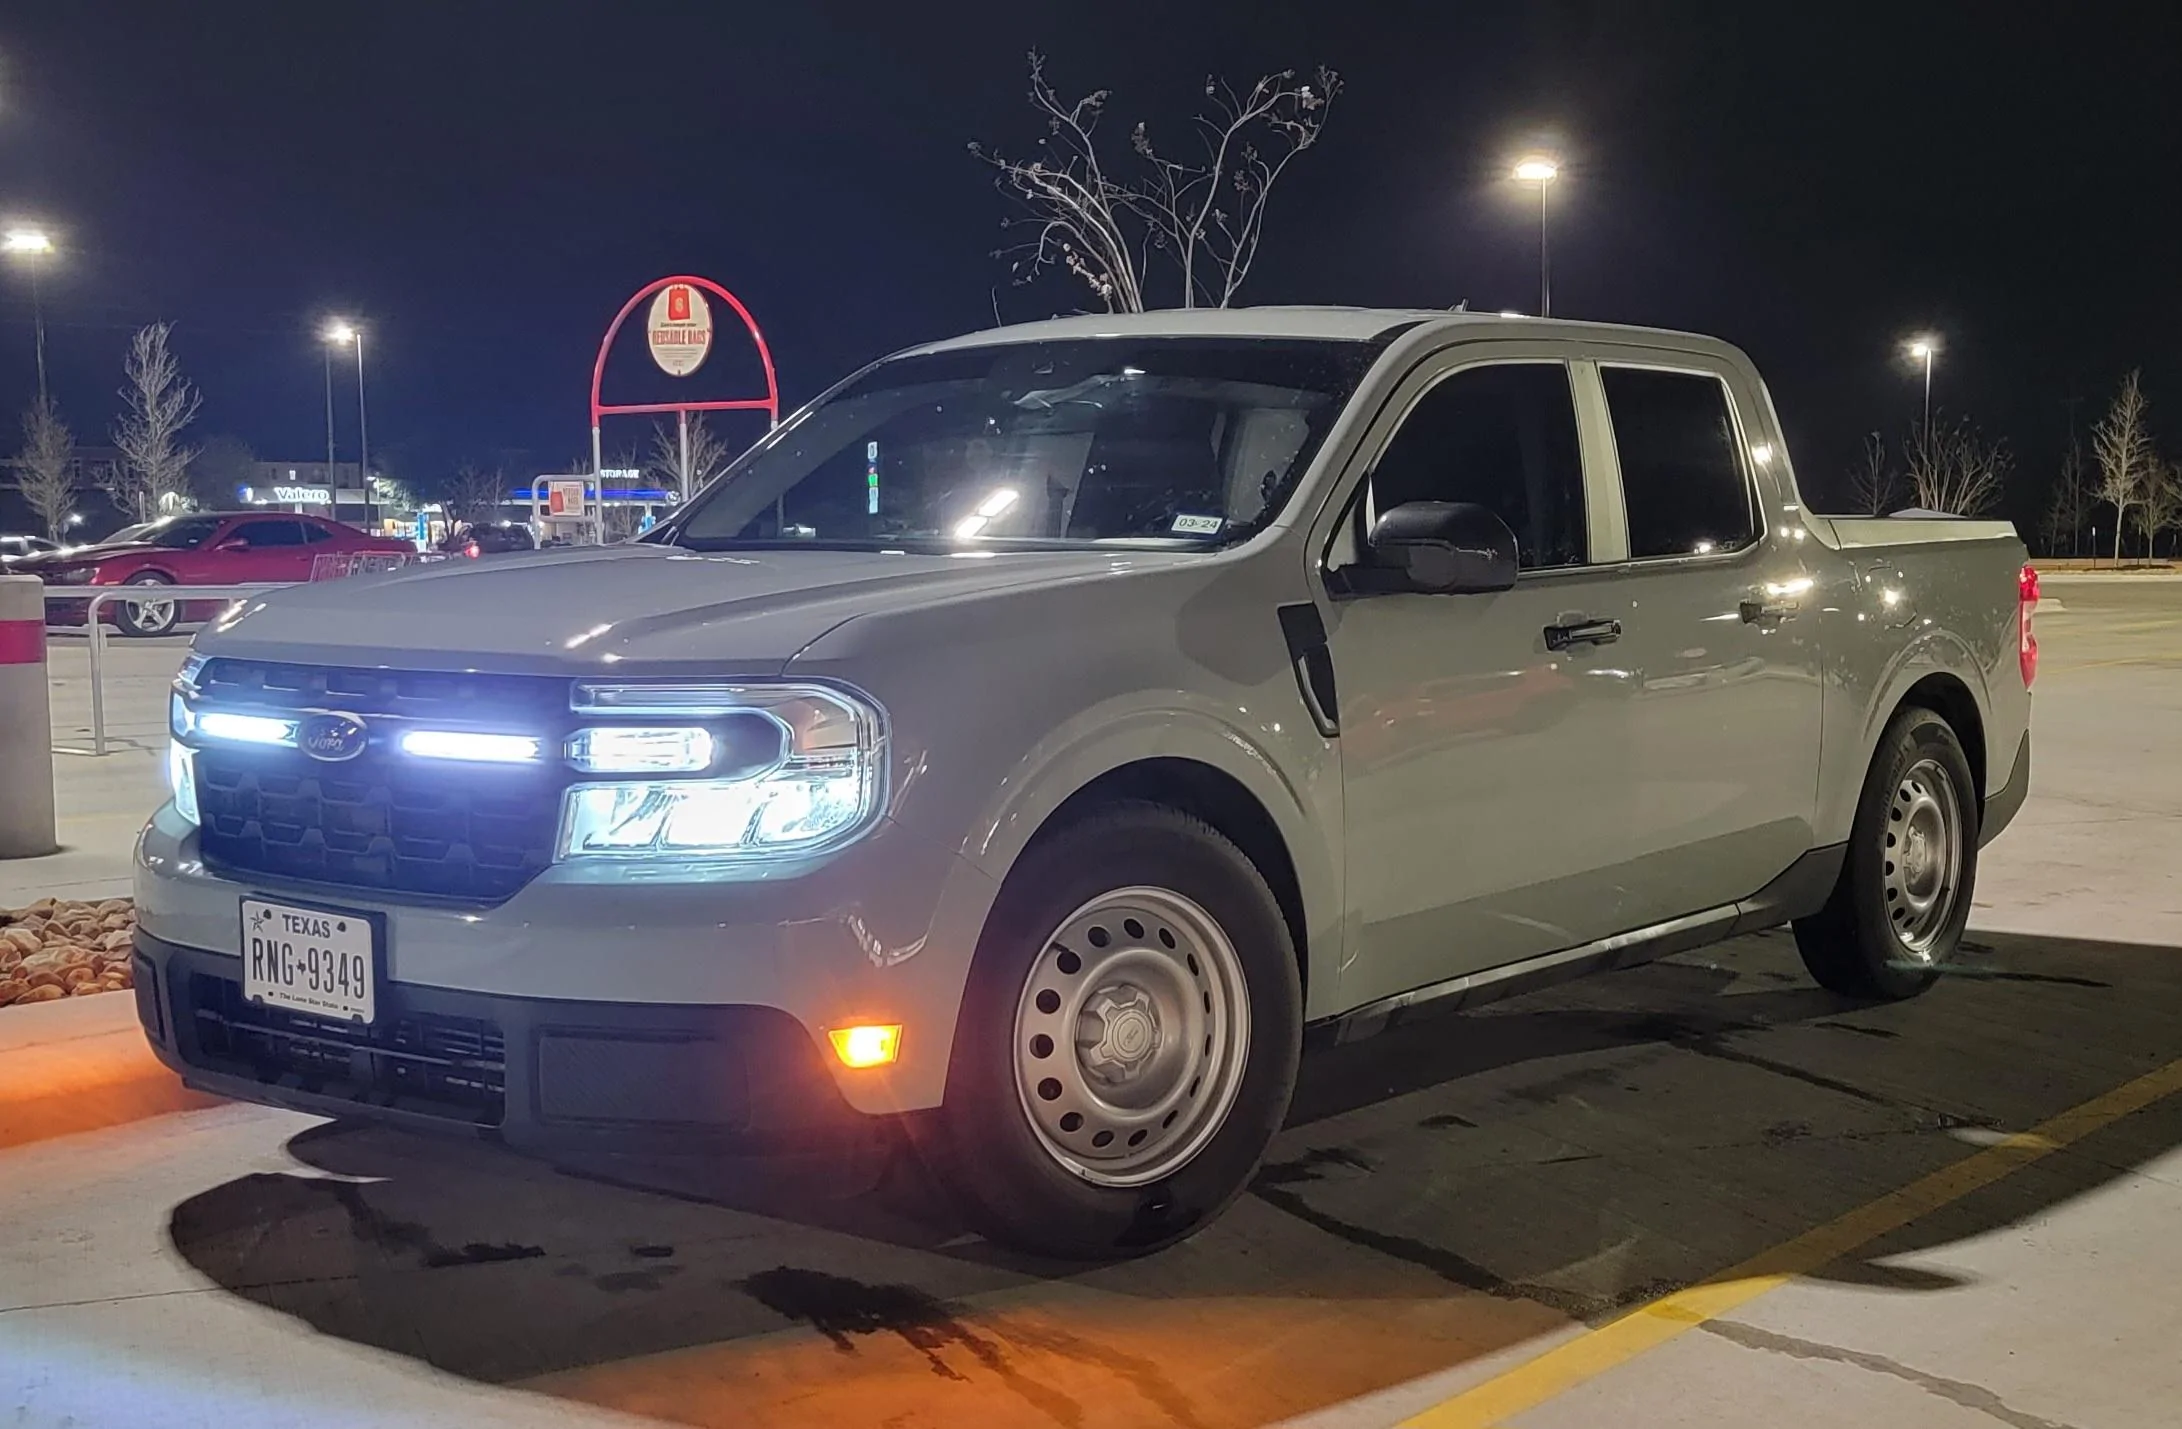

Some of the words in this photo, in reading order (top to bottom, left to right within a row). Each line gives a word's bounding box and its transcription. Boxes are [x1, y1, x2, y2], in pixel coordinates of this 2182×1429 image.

[274, 487, 330, 502] Valero
[282, 914, 331, 939] TEXAS
[279, 992, 290, 1000] The
